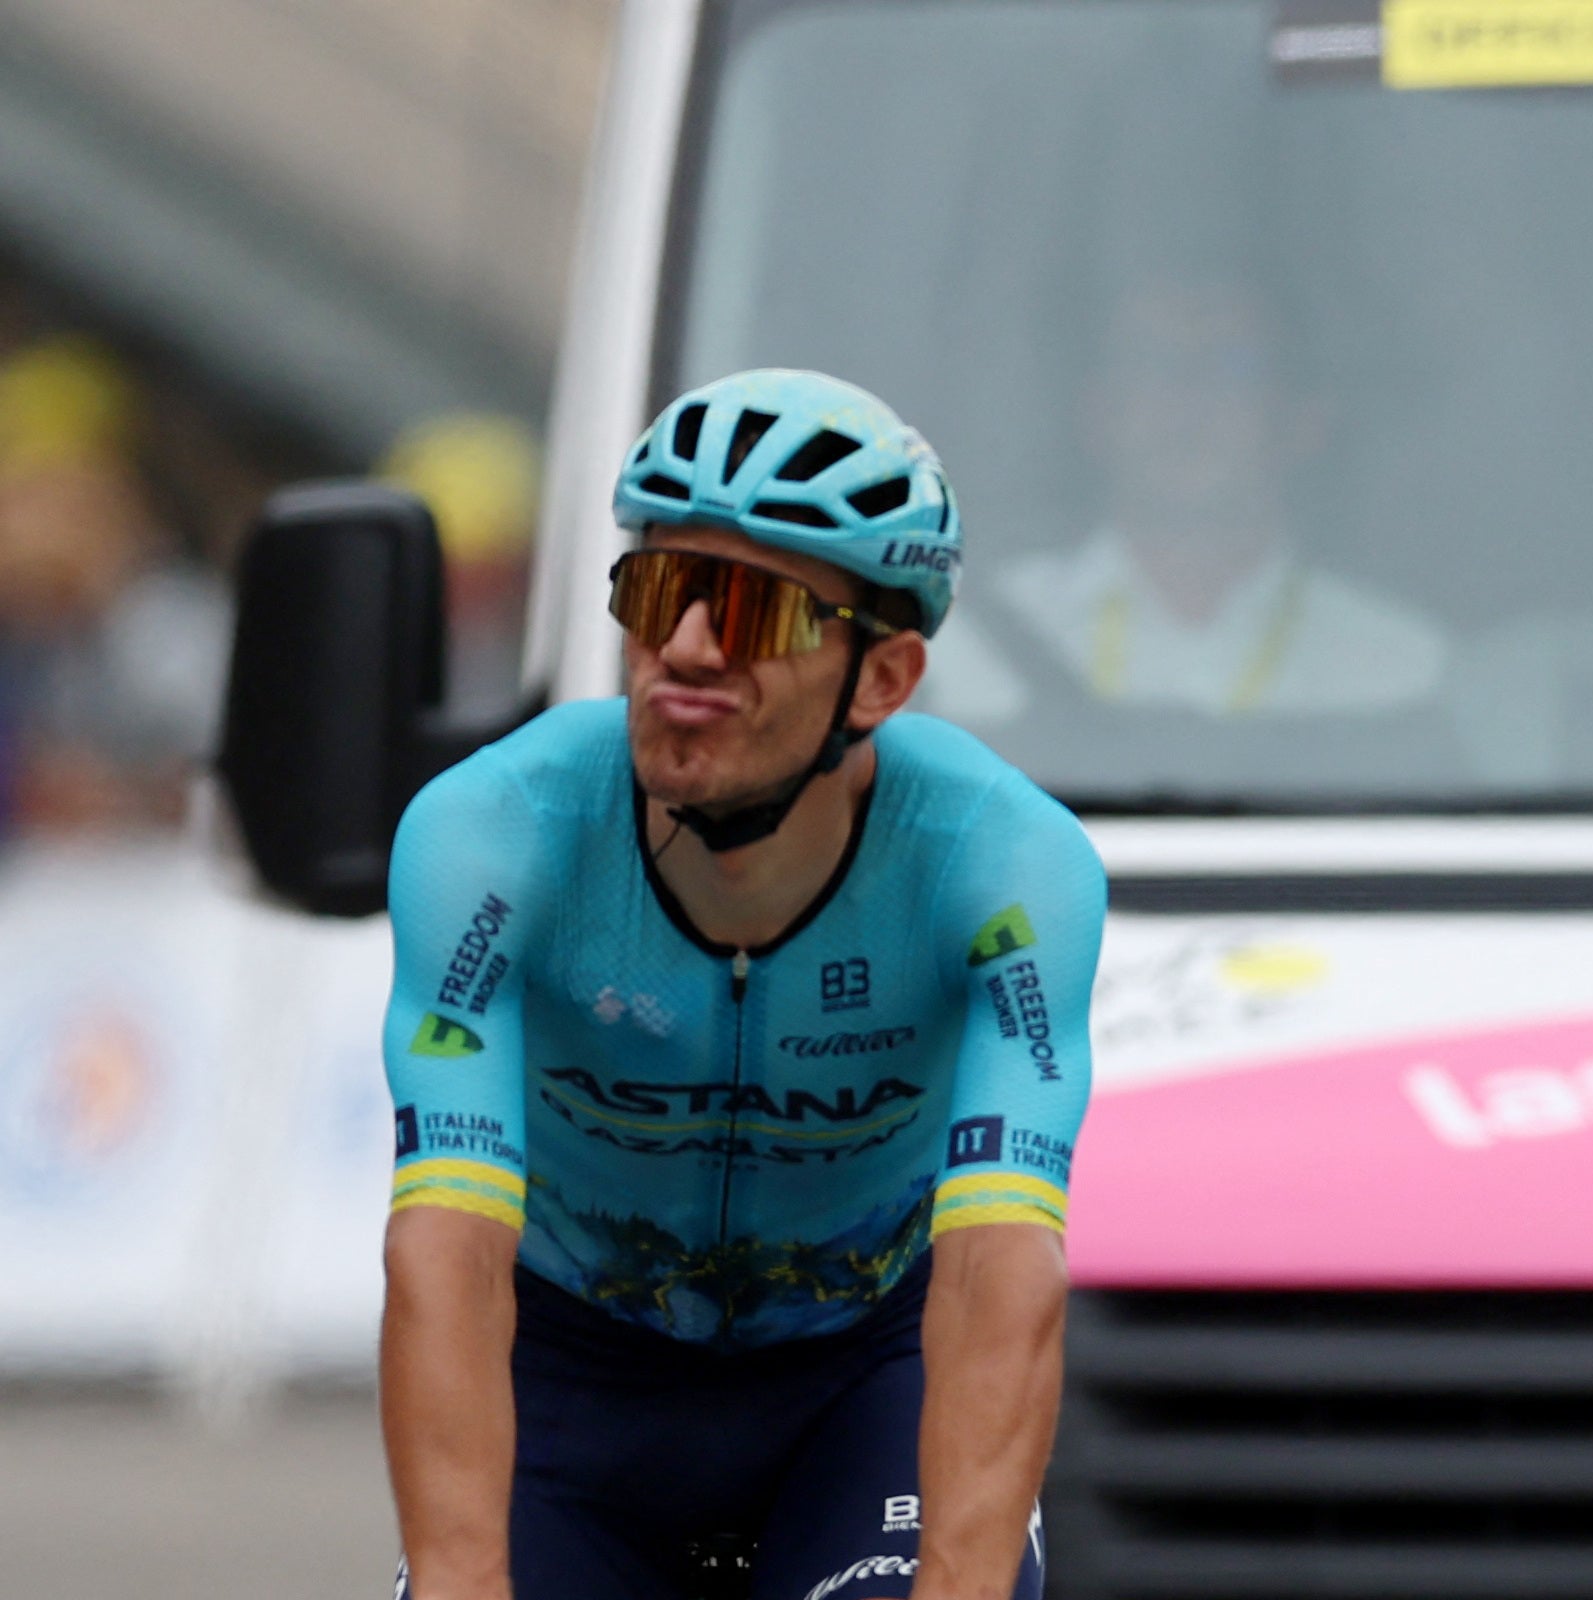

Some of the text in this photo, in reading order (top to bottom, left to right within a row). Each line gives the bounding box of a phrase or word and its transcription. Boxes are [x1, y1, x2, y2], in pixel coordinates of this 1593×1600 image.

[438, 891, 513, 1009] FREEDOM
[821, 957, 871, 1001] B3
[1006, 960, 1062, 1082] FREEDOM
[540, 1066, 926, 1122] ASTANA
[424, 1110, 504, 1136] ITALIAN
[957, 1126, 987, 1155] IT
[884, 1494, 920, 1523] B
